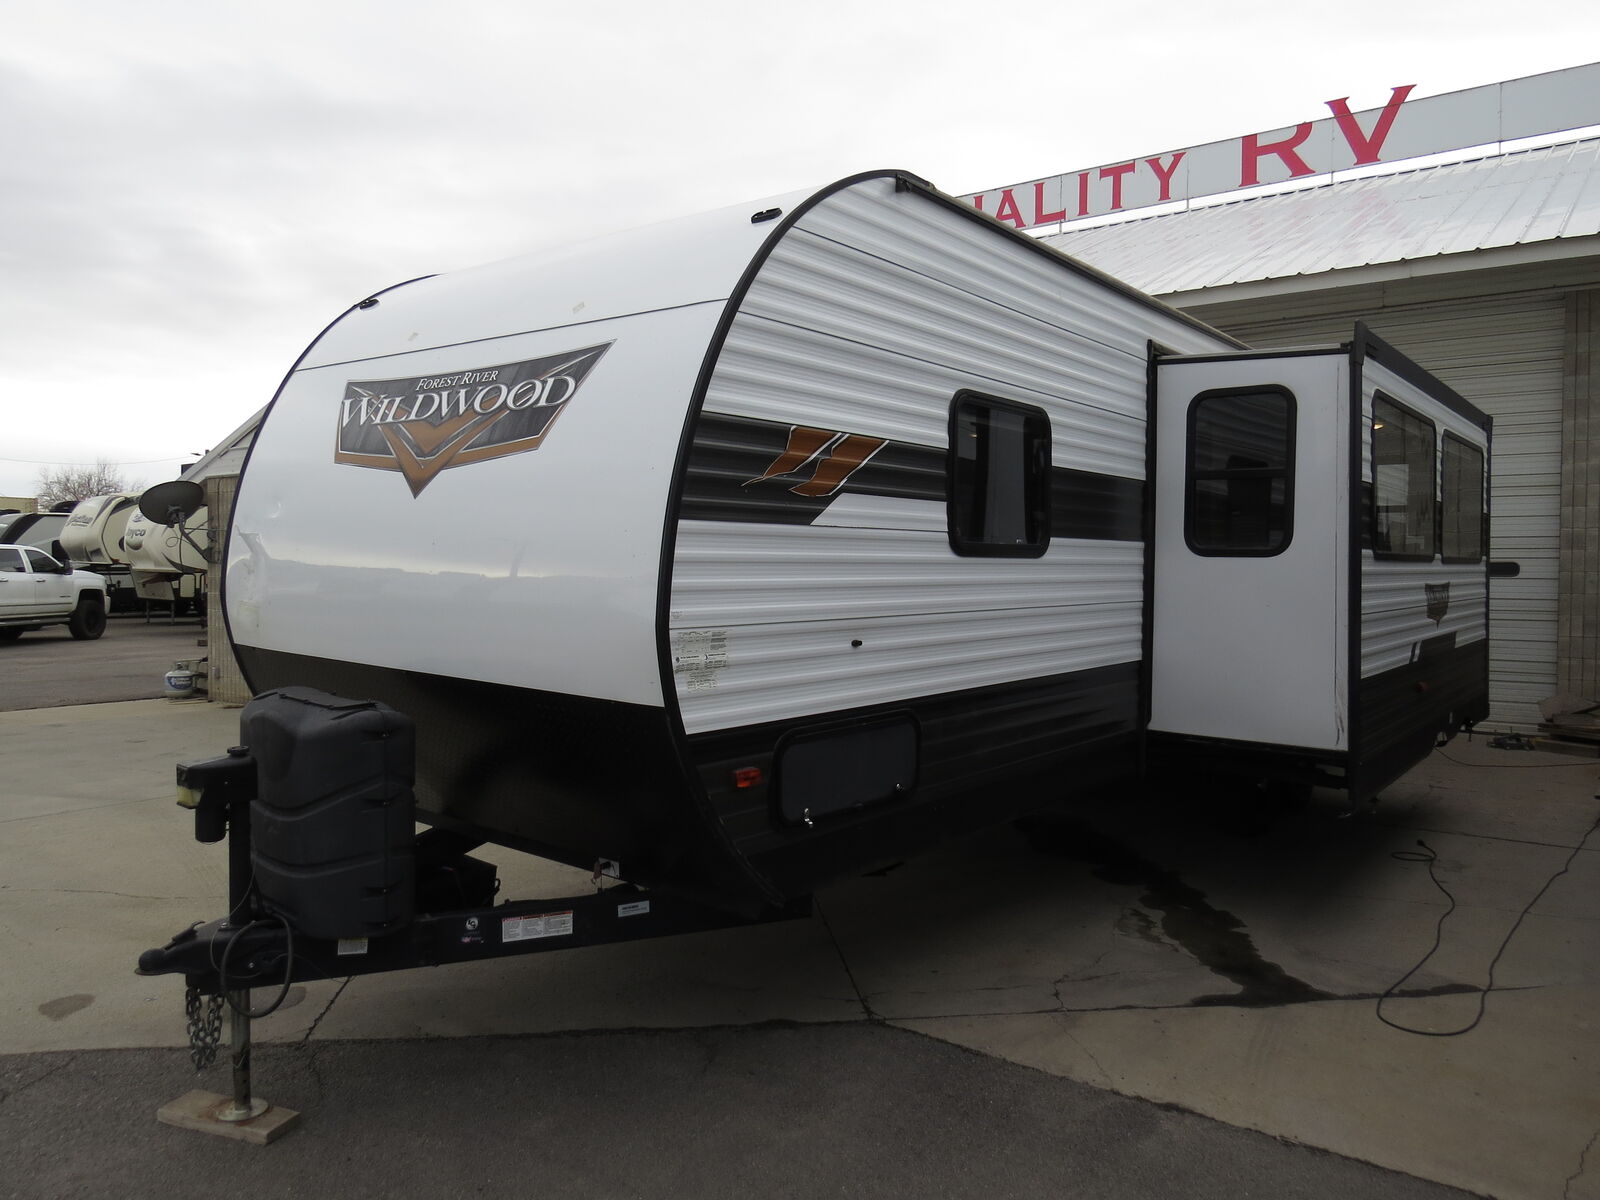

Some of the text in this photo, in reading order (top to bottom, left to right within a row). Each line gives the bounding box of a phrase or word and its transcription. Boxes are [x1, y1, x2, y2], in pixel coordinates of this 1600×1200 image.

[1238, 84, 1418, 188] RV
[341, 375, 577, 429] WILDWOOD
[415, 370, 499, 391] FOREST RIVER
